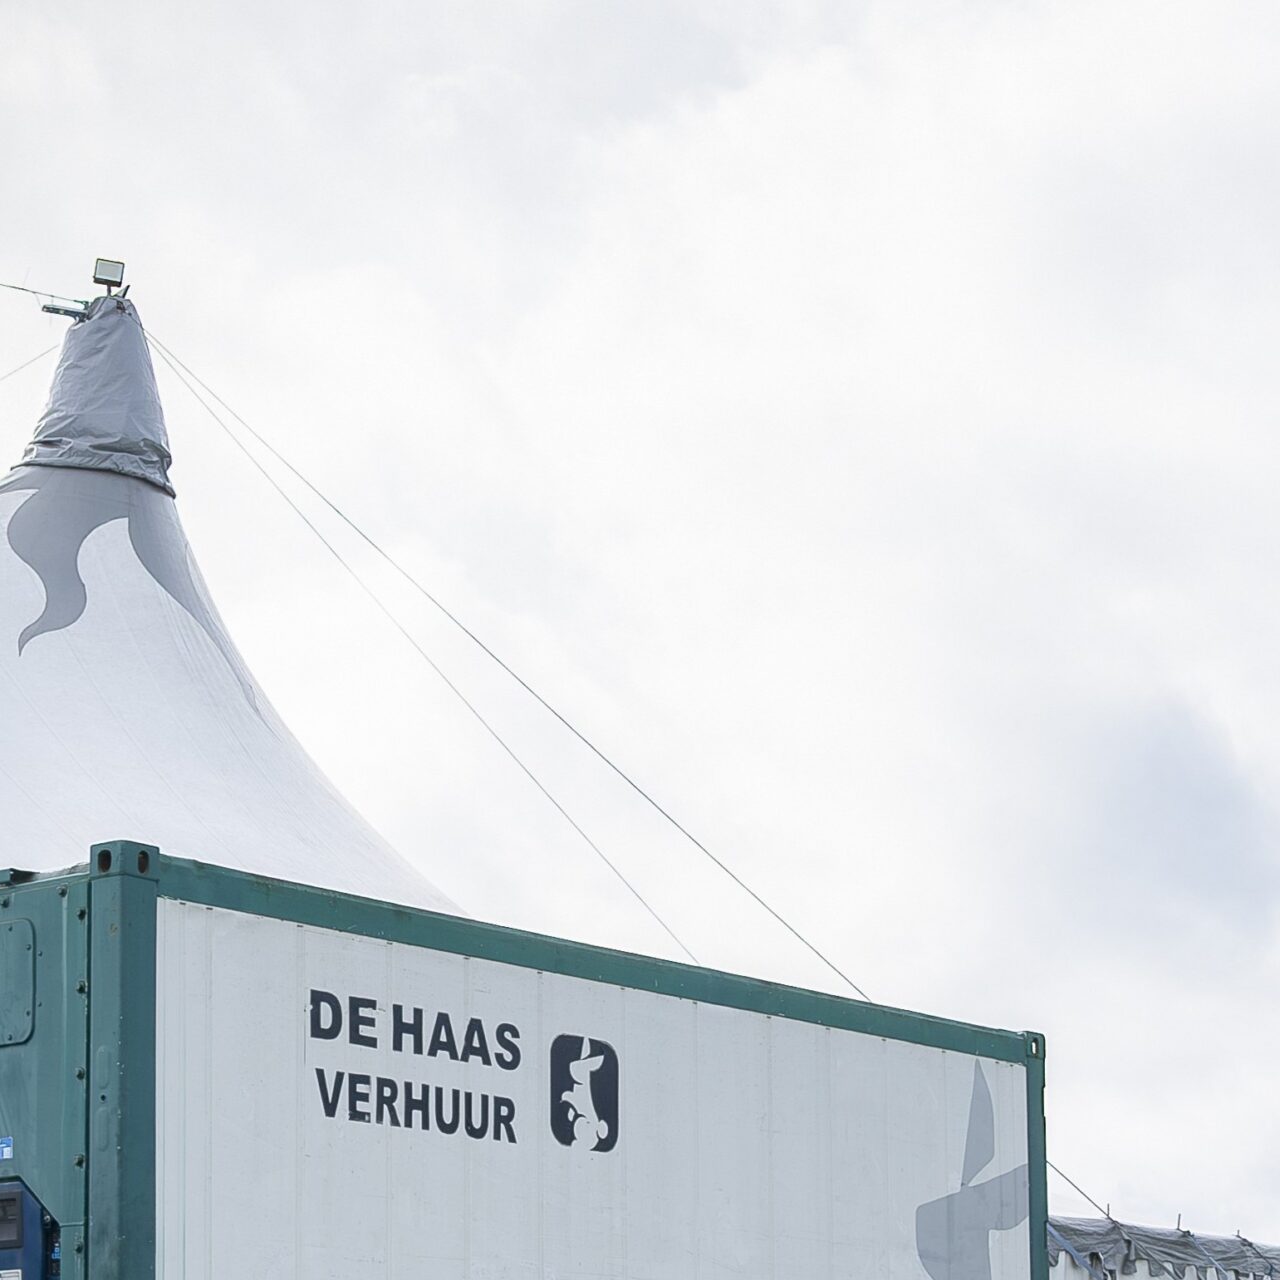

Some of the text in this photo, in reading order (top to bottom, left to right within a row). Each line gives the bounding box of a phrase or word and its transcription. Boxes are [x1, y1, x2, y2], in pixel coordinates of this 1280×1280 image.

[310, 989, 521, 1071] DE HAAS
[315, 1068, 517, 1144] VERHUUR
